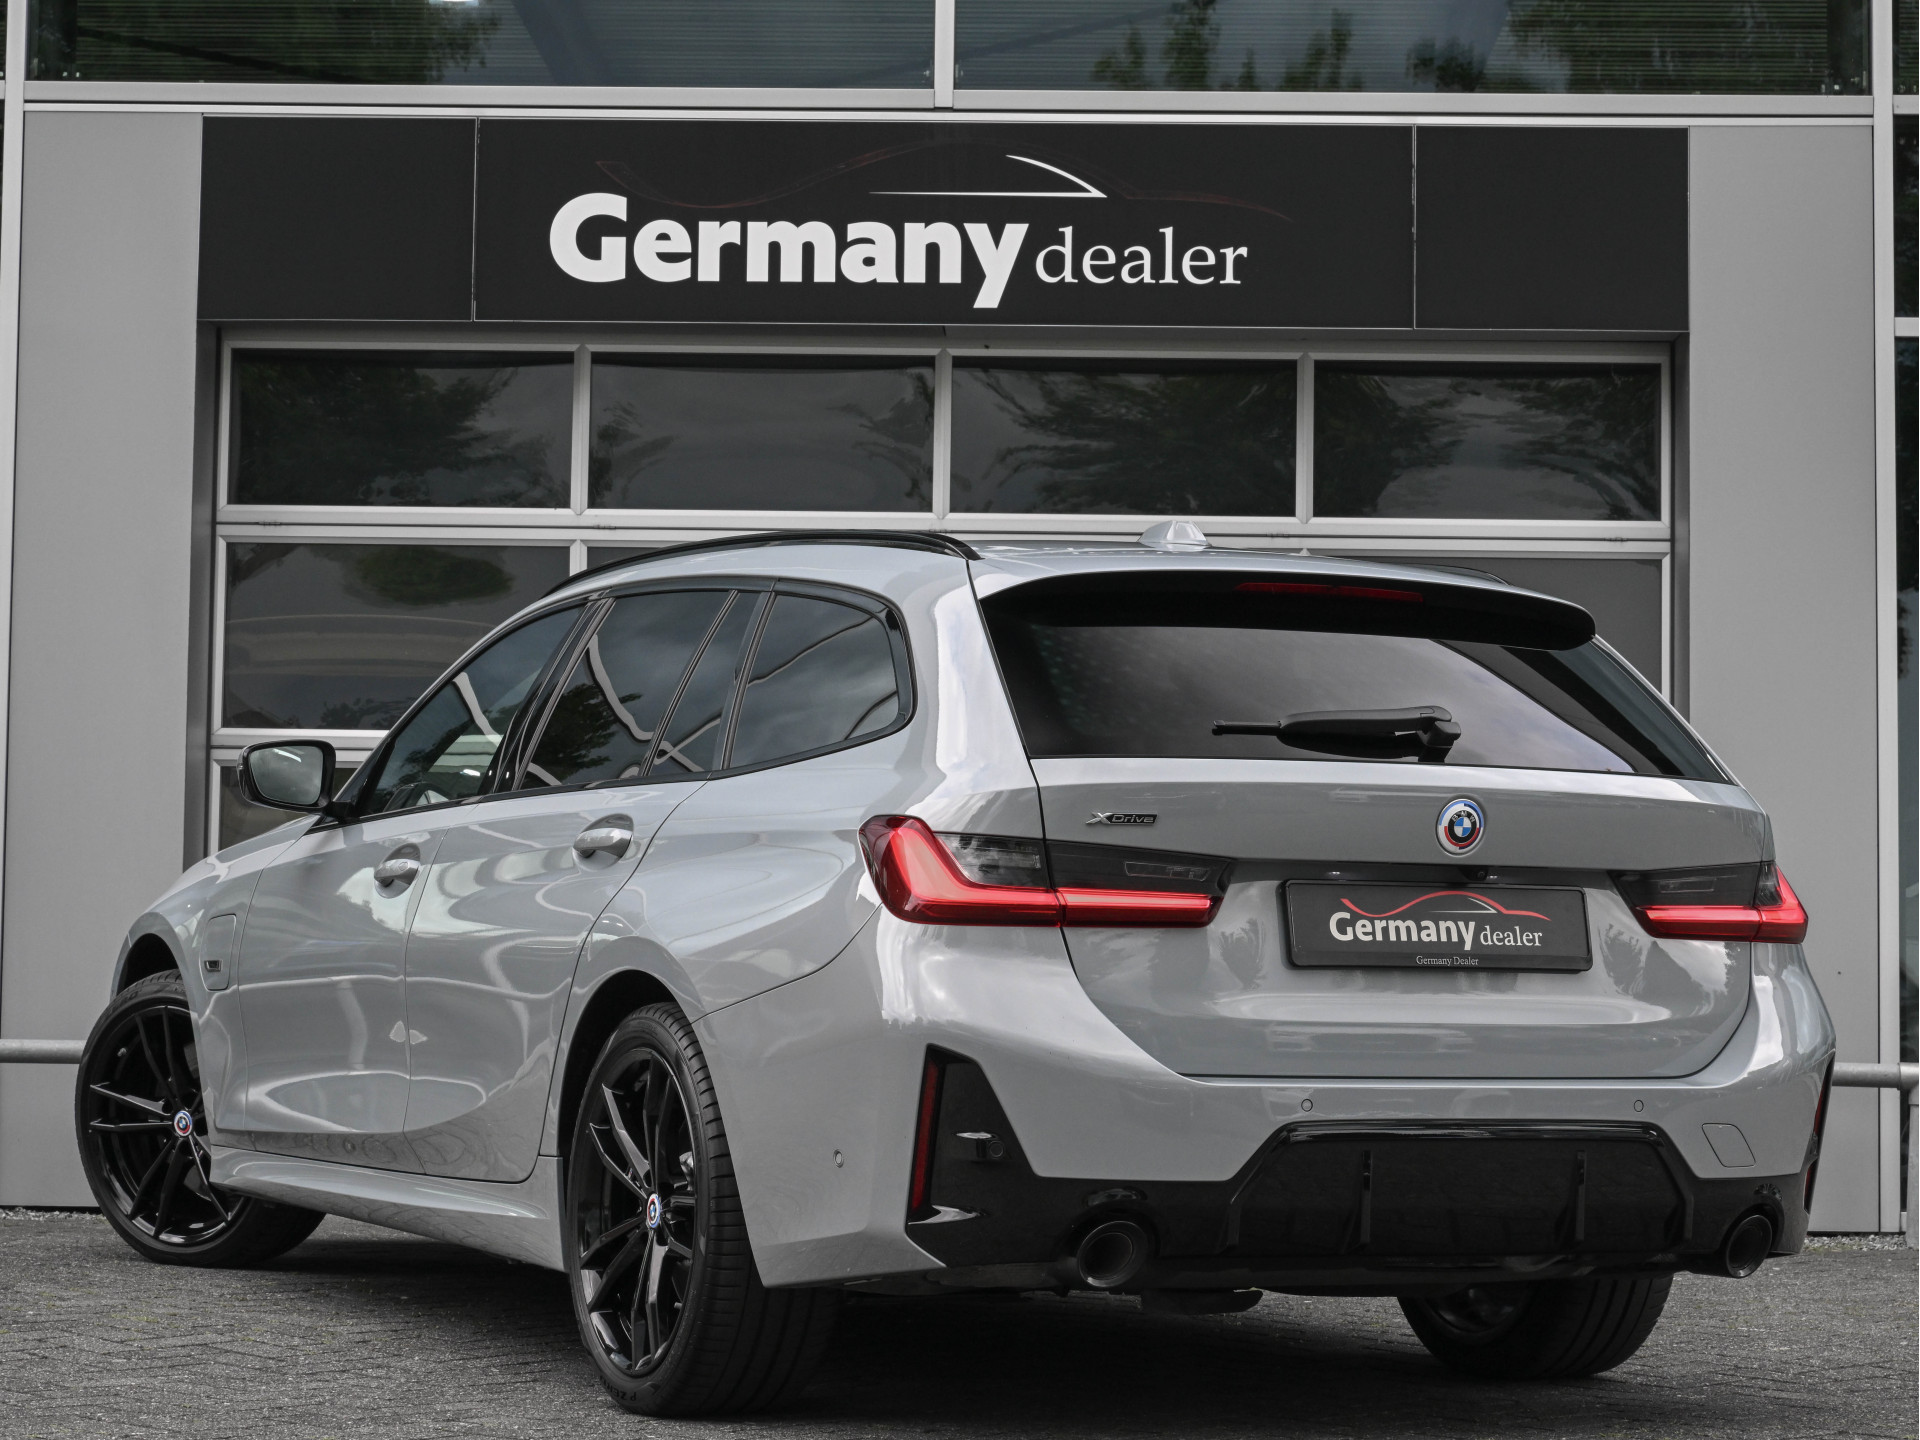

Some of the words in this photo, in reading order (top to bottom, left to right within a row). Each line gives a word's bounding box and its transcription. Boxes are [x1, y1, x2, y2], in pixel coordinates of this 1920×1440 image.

[550, 192, 1029, 308] Germany
[1036, 226, 1248, 285] dealer
[1329, 911, 1476, 951] Germany
[1480, 925, 1543, 947] dealer
[1416, 955, 1452, 967] Germany
[1453, 956, 1479, 966] Dealer
